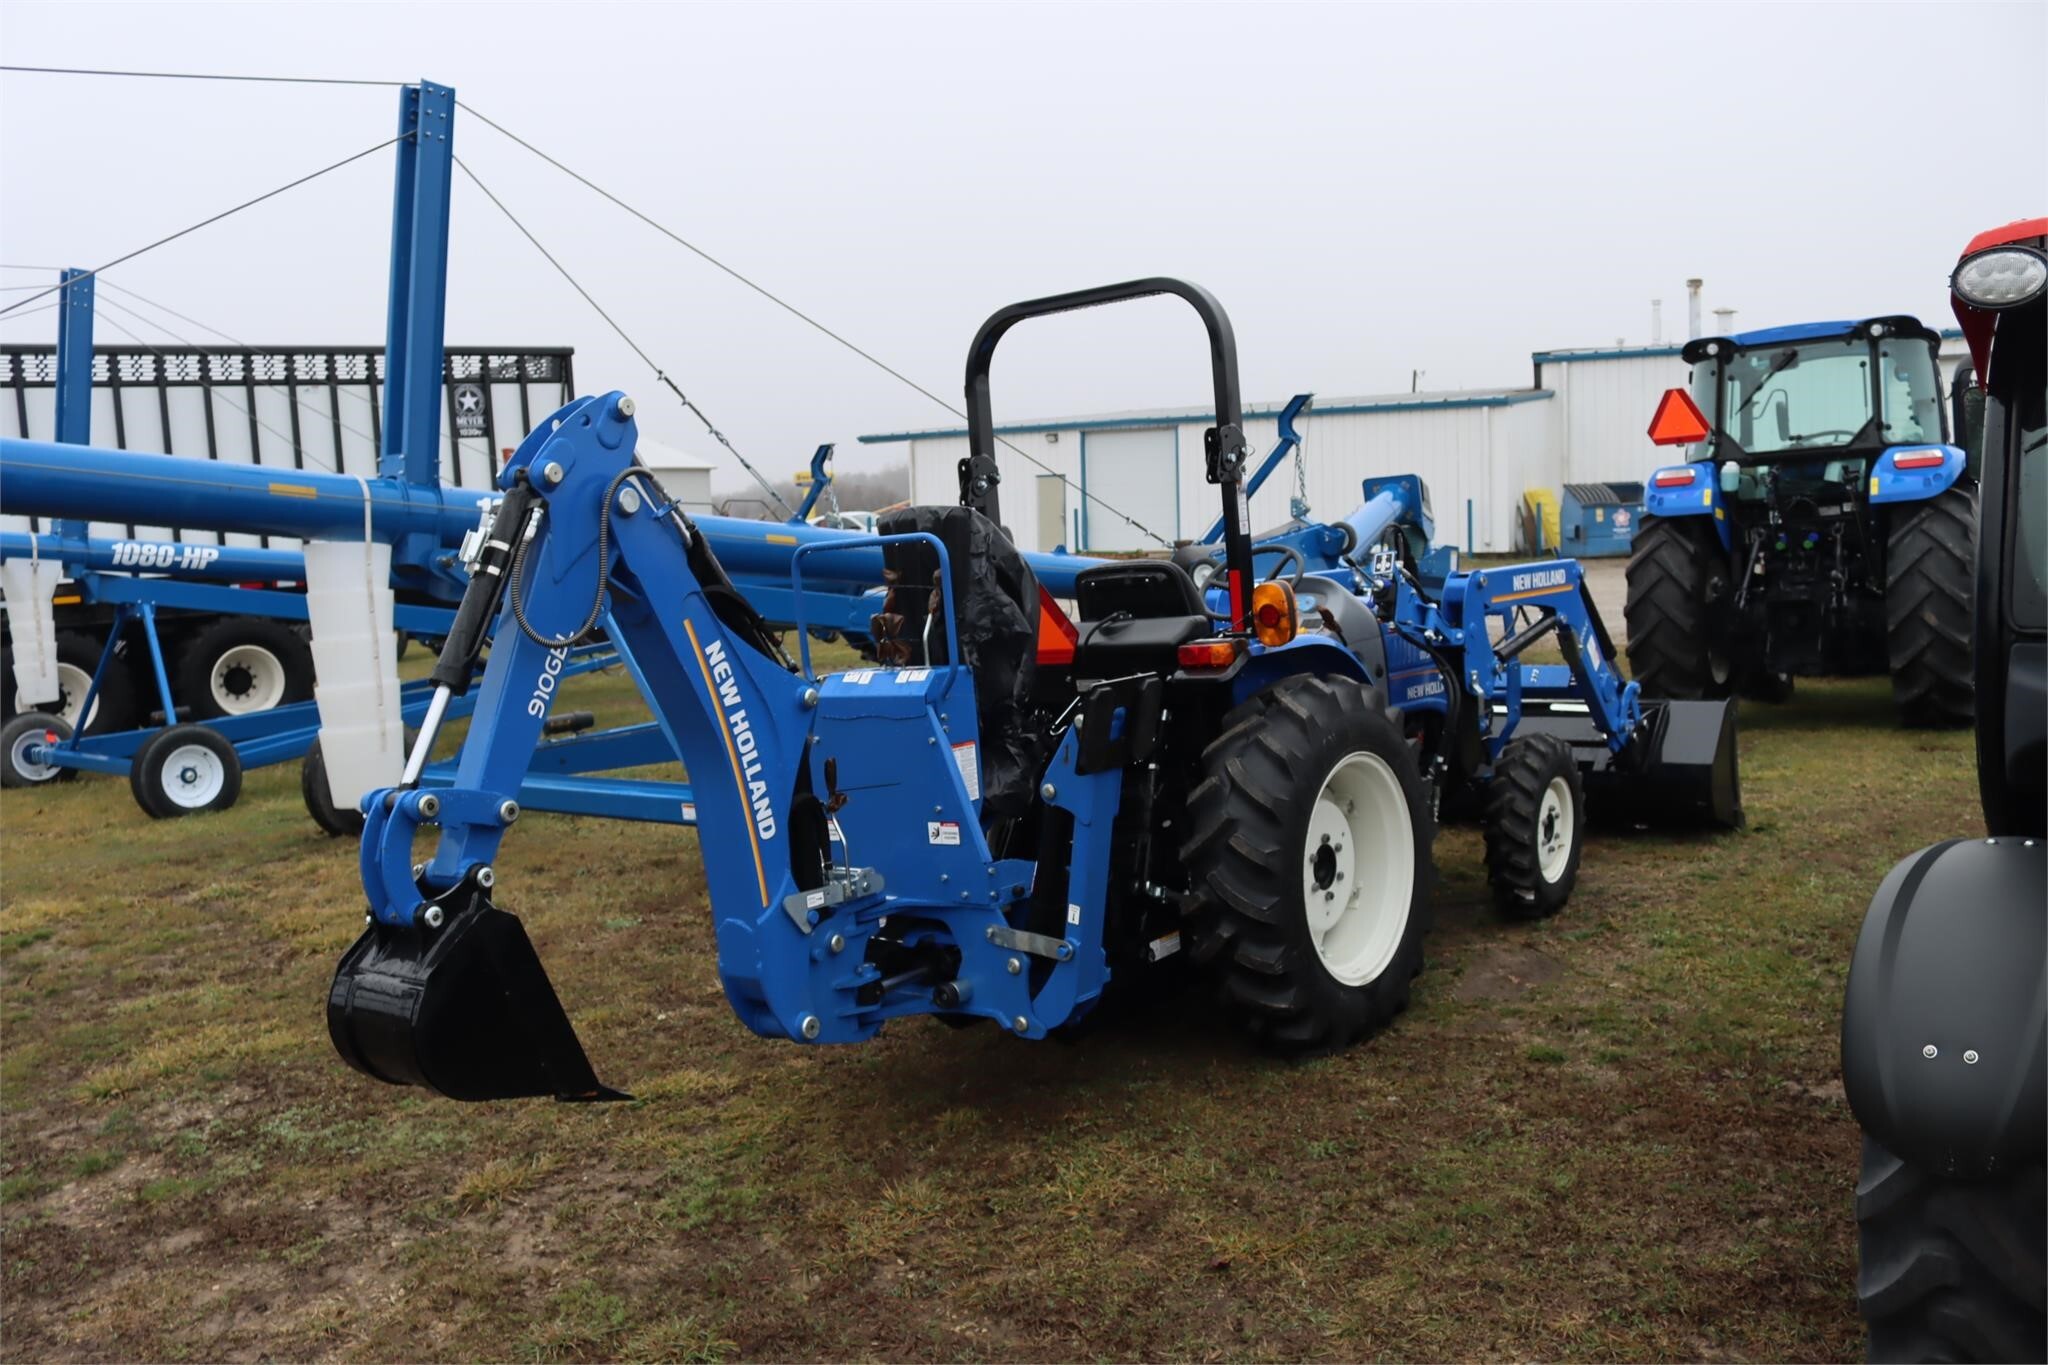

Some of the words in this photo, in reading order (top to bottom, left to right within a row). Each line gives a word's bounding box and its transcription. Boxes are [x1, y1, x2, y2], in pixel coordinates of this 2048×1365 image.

[111, 542, 219, 570] 1080-HP
[1513, 573, 1531, 591] NEW
[1532, 568, 1566, 588] HOLLAND
[1407, 685, 1424, 700] NEW
[704, 639, 742, 707] NEW
[729, 709, 777, 840] HOLLAND
